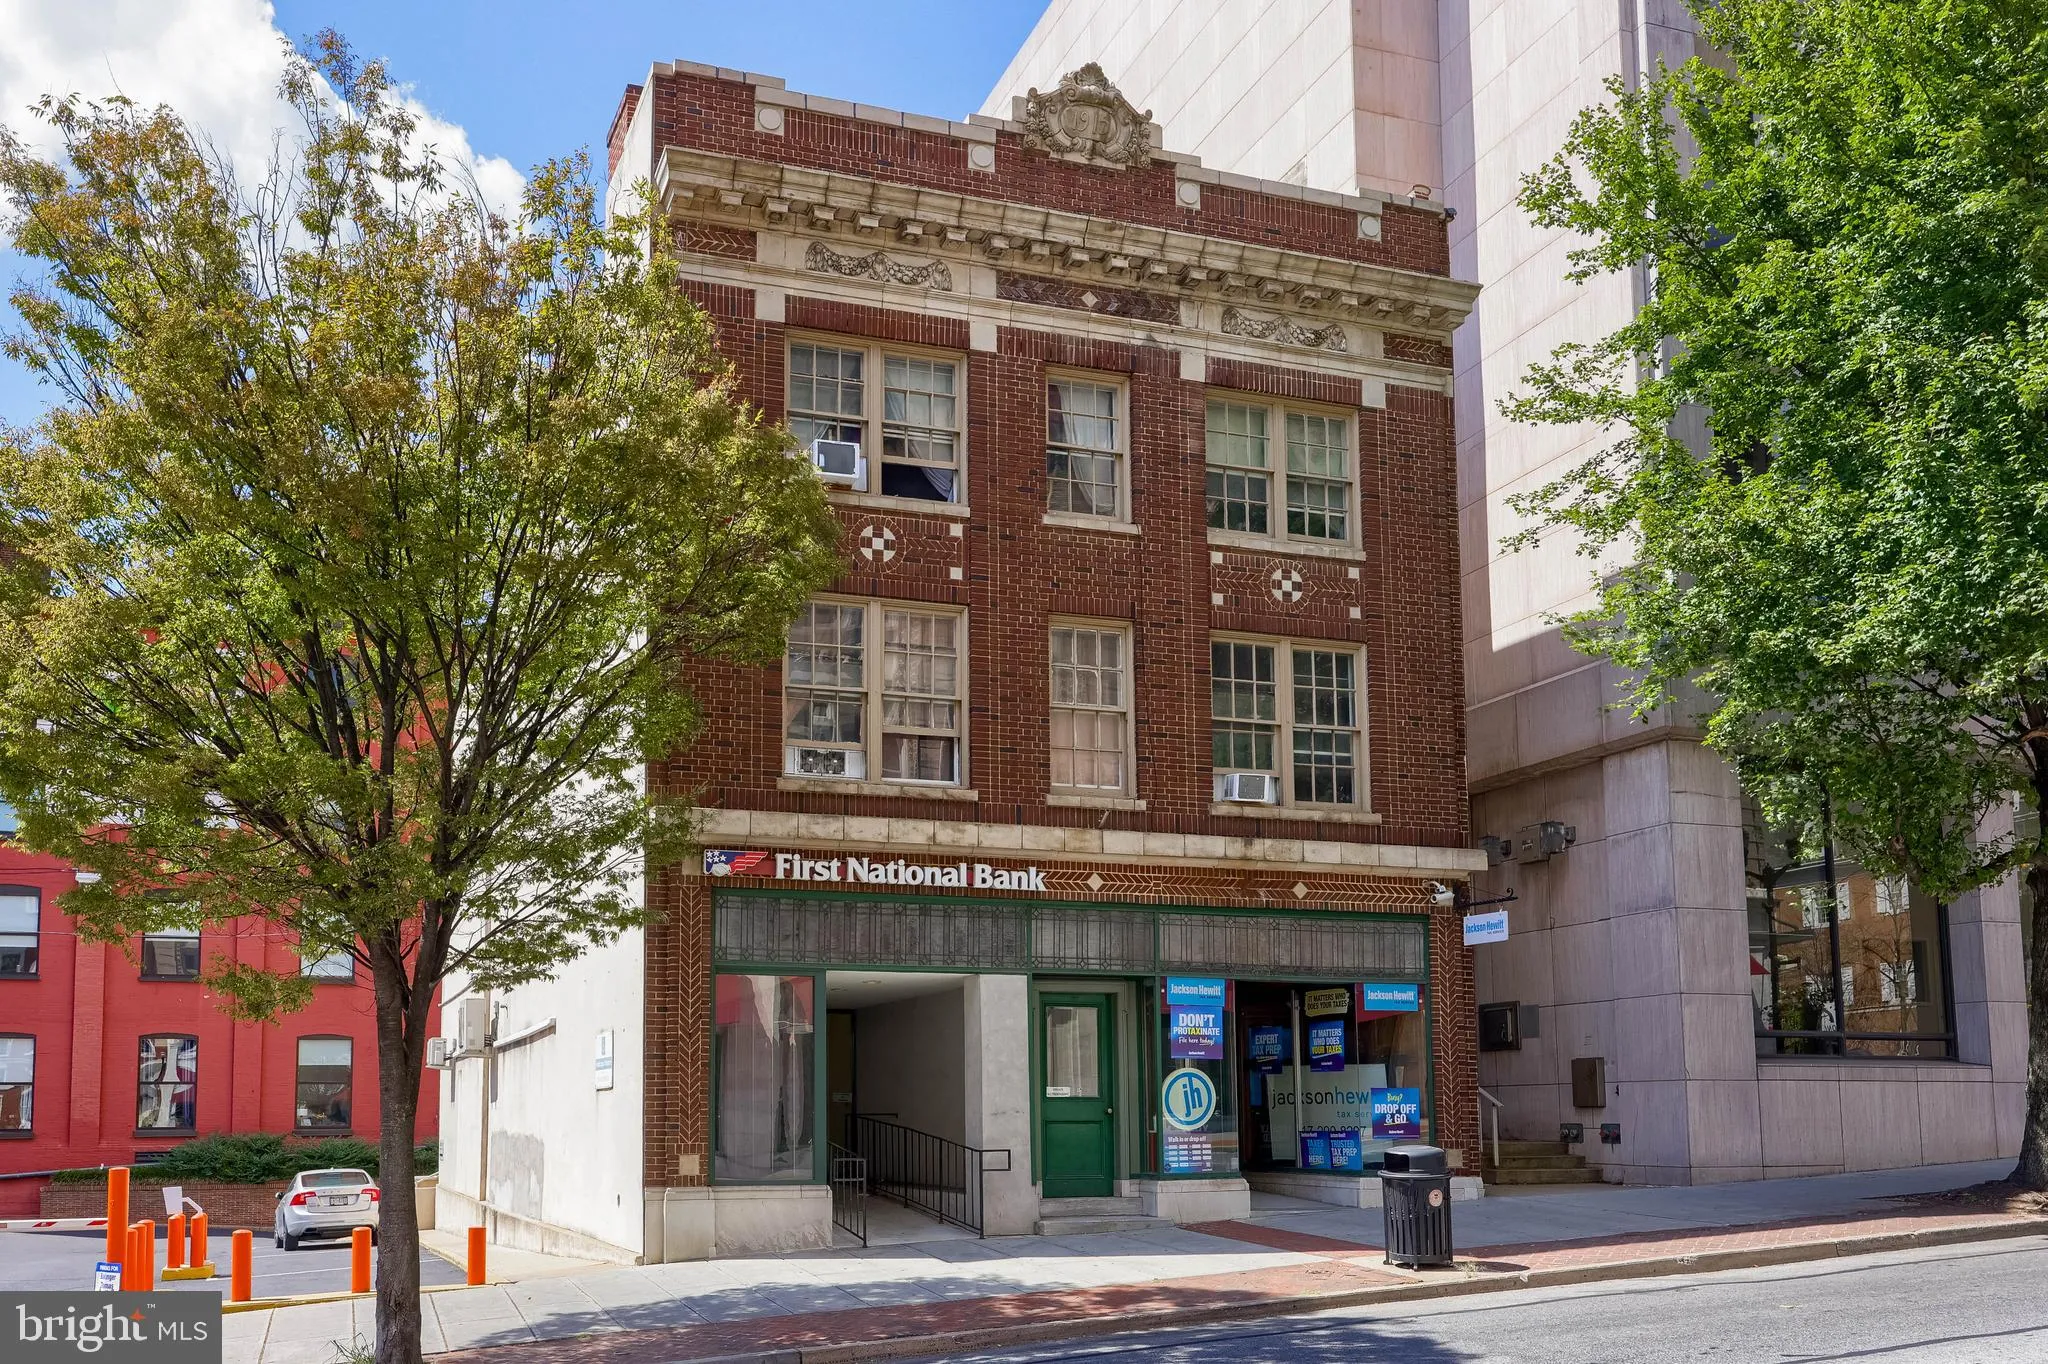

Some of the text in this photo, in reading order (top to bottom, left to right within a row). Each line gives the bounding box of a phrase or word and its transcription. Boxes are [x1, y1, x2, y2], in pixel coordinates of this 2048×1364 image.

[1073, 111, 1112, 135] 1915
[775, 854, 1046, 891] First National Bank
[1465, 920, 1504, 934] Jackson Hewitt
[1171, 984, 1221, 996] Jackson Hewitt
[1368, 990, 1415, 1001] Jackson Hewitt
[1333, 1000, 1347, 1008] TAXES
[1179, 1014, 1215, 1027] DON'T
[1173, 1027, 1220, 1036] PROTAXINATE
[1311, 1028, 1342, 1038] IT MATTERS
[1178, 1036, 1216, 1047] File here today!
[1255, 1033, 1279, 1045] EXPERT
[1313, 1036, 1340, 1046] WHO DOES
[1252, 1043, 1282, 1055] TAX PREP
[1311, 1044, 1342, 1054] YOUR TAXES
[1374, 1104, 1417, 1114] DROP OFF
[1385, 1114, 1407, 1124] & GO
[1330, 1139, 1355, 1148] TRUSTED
[1331, 1147, 1342, 1156] TAX
[1342, 1148, 1358, 1156] PREP
